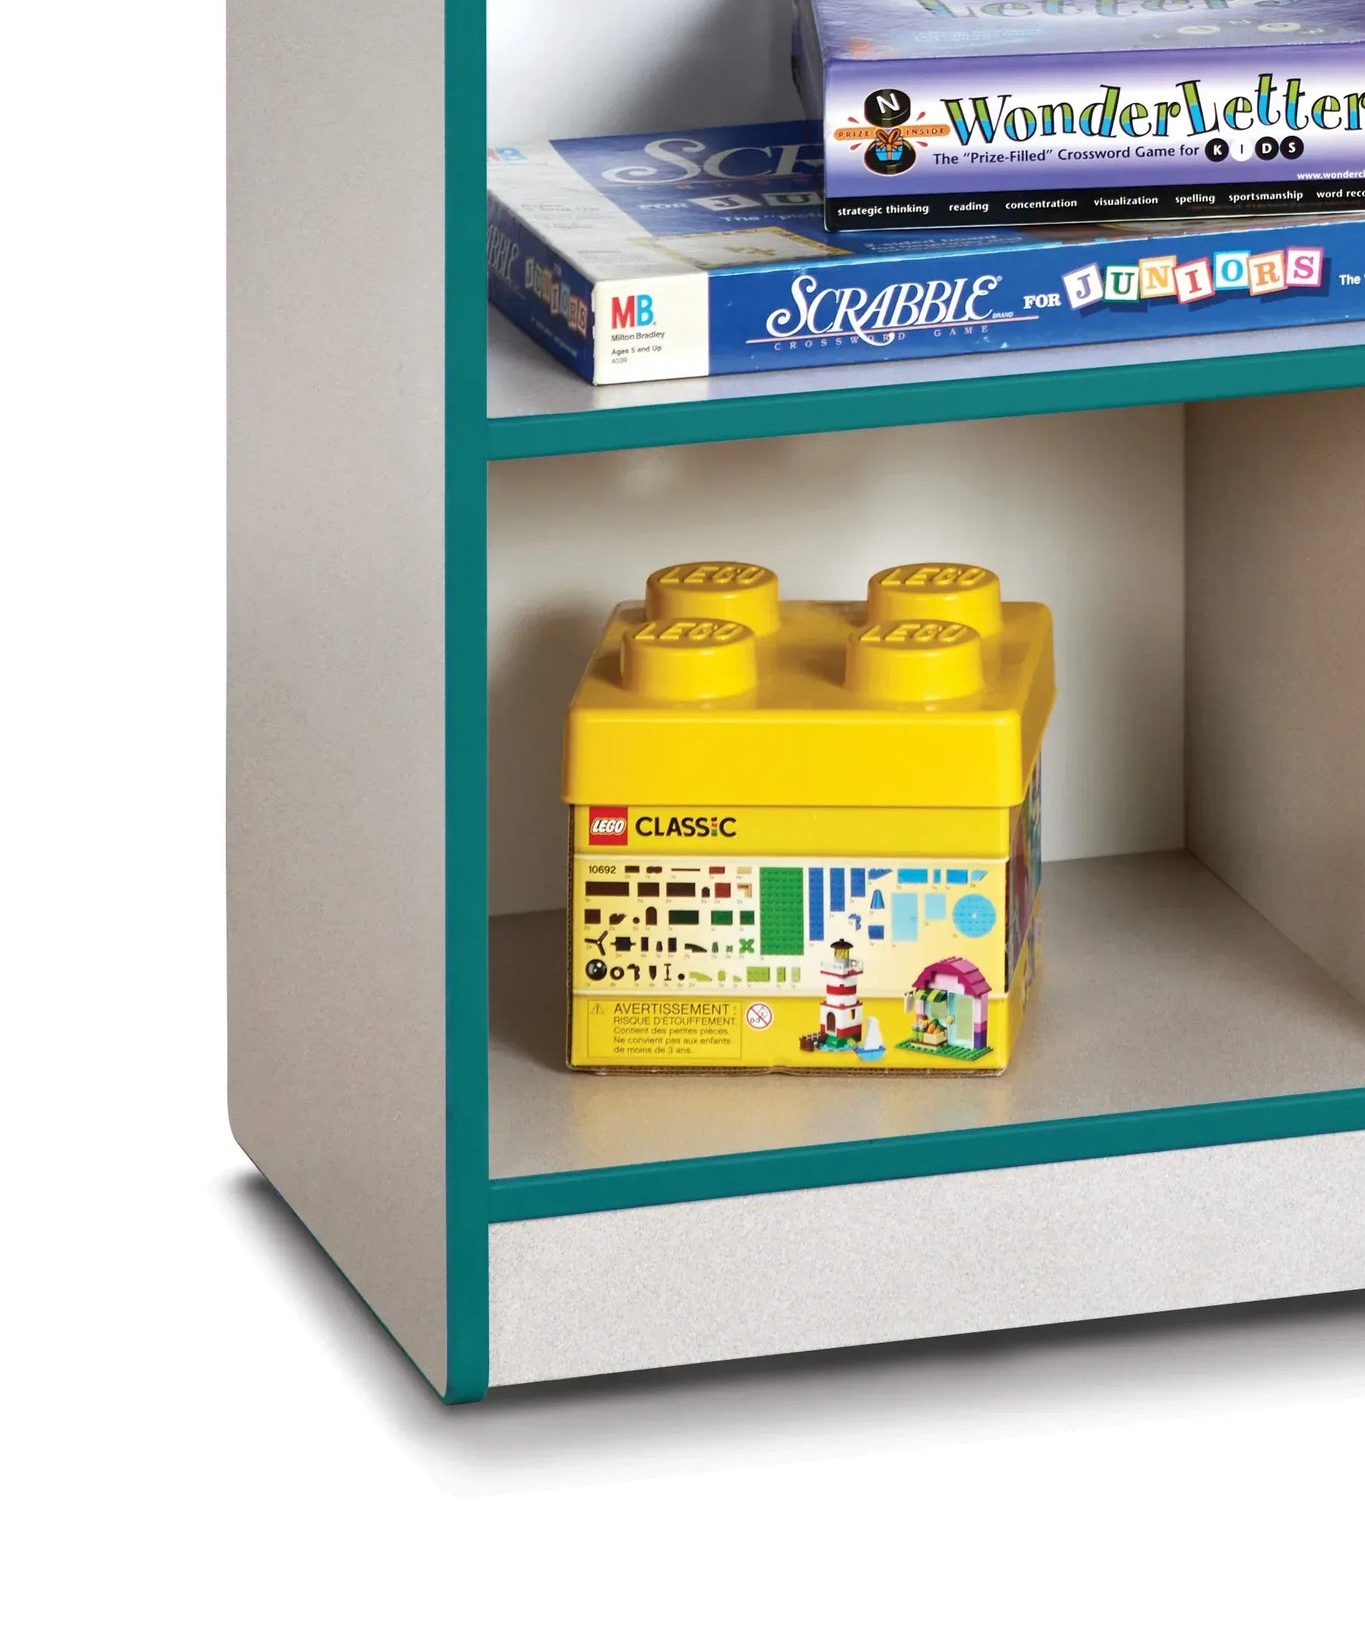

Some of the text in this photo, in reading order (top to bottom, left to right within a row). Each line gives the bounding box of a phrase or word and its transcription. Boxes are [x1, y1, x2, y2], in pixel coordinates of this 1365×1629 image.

[876, 93, 900, 114] N
[838, 127, 944, 139] PRIZE INSIDE
[933, 153, 958, 165] The
[1058, 146, 1130, 160] Crossword
[1135, 145, 1175, 159] Game
[1180, 144, 1199, 156] for
[1210, 140, 1298, 157] KIDS
[837, 206, 883, 217] strategic
[886, 203, 929, 215] thinking
[949, 202, 989, 213] reading
[1005, 198, 1078, 210] concentration
[1094, 196, 1158, 207] visualization
[1175, 194, 1215, 205] spelling
[1228, 190, 1303, 203] sportsmanship
[1316, 188, 1343, 199] word
[1339, 274, 1361, 285] The
[992, 311, 1014, 319] BRAND
[1023, 294, 1061, 309] FOR
[1072, 254, 1317, 302] JUNIORS
[611, 294, 654, 329] MB
[611, 331, 665, 342] Milton Bradley
[933, 325, 988, 337] GAME
[611, 347, 629, 356] Ages
[652, 344, 662, 352] Up
[660, 565, 765, 584] LEGO
[881, 567, 986, 586] LEGO
[634, 621, 745, 641] LEGO
[860, 624, 968, 642] LEGO
[591, 818, 626, 835] LEGO
[588, 866, 616, 874] 10692
[614, 1003, 729, 1015] AVERTISSEMENT
[614, 1017, 650, 1026] RISQUE
[614, 1027, 649, 1035] Contient
[651, 1027, 667, 1035] des
[669, 1027, 698, 1037] petites
[614, 1037, 625, 1045] Ne
[627, 1037, 663, 1045] convient
[665, 1038, 681, 1047] pas
[700, 1037, 731, 1045] enfants
[614, 1046, 625, 1054] de
[627, 1046, 651, 1054] moins
[654, 1046, 665, 1054] de
[668, 1046, 673, 1054] 3
